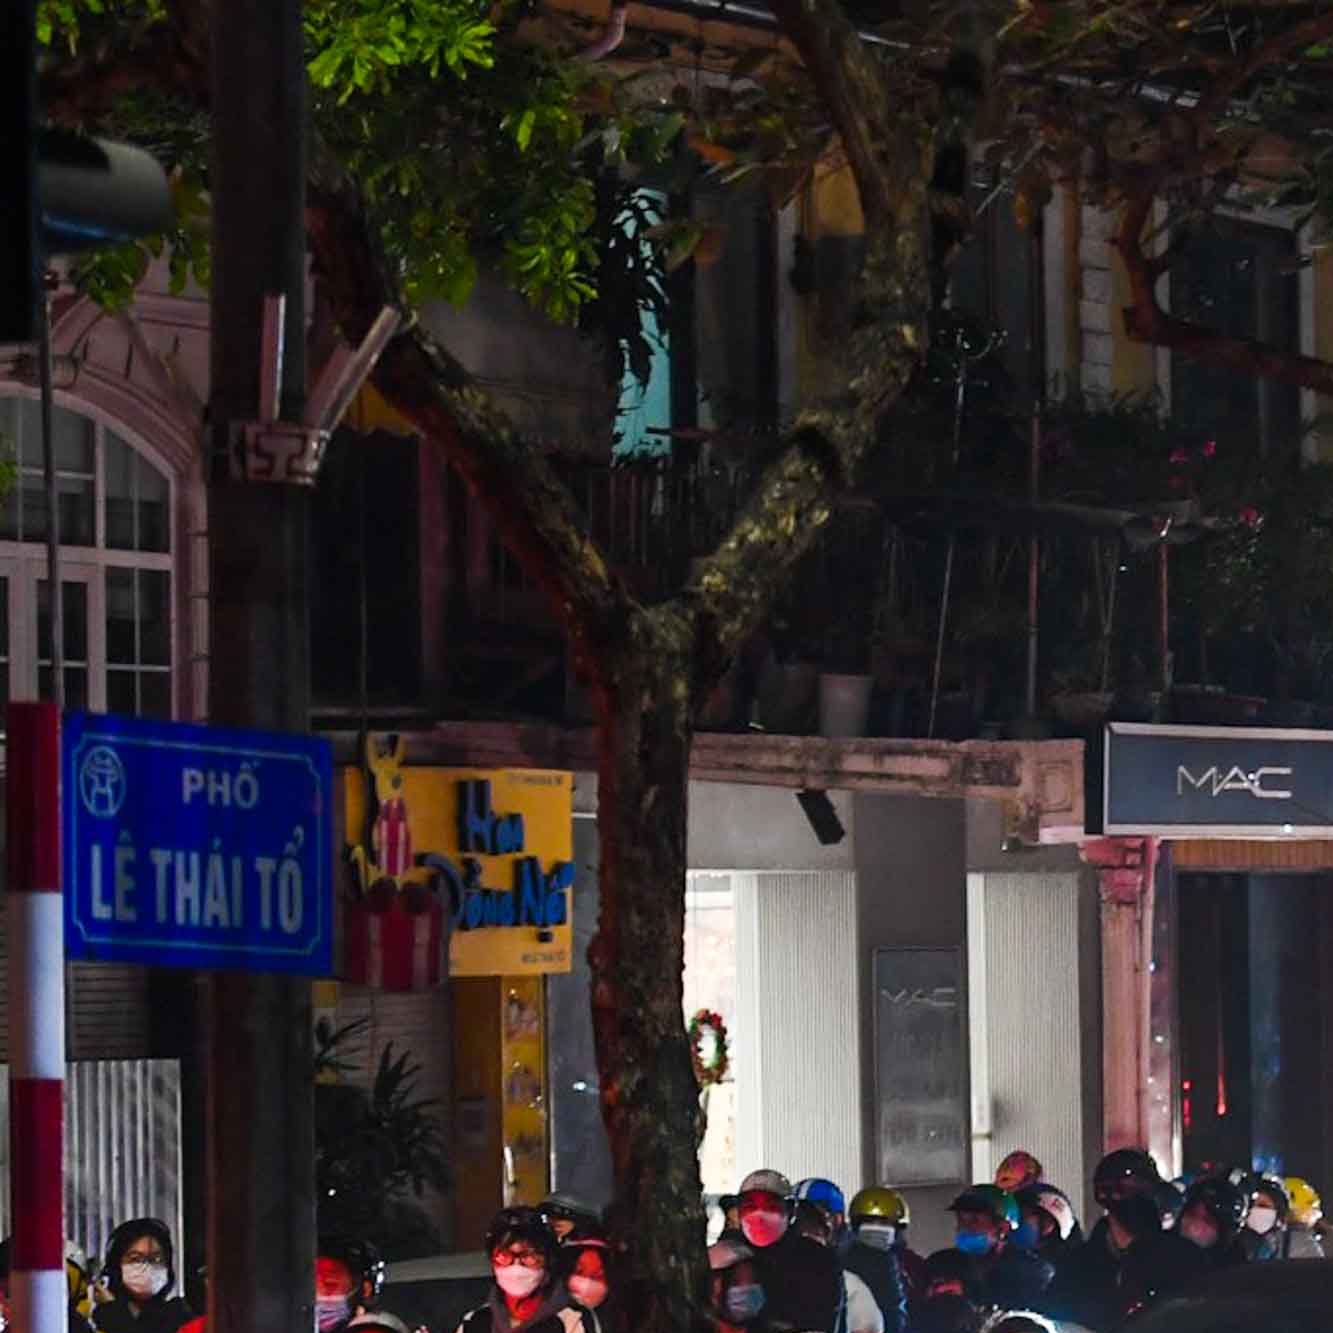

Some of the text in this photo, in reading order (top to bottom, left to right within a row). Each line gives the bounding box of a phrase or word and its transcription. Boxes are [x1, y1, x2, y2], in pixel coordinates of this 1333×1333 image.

[182, 761, 260, 809] PHỐ
[1177, 765, 1292, 798] MAC
[91, 825, 305, 934] LÊ THÁI TỔ
